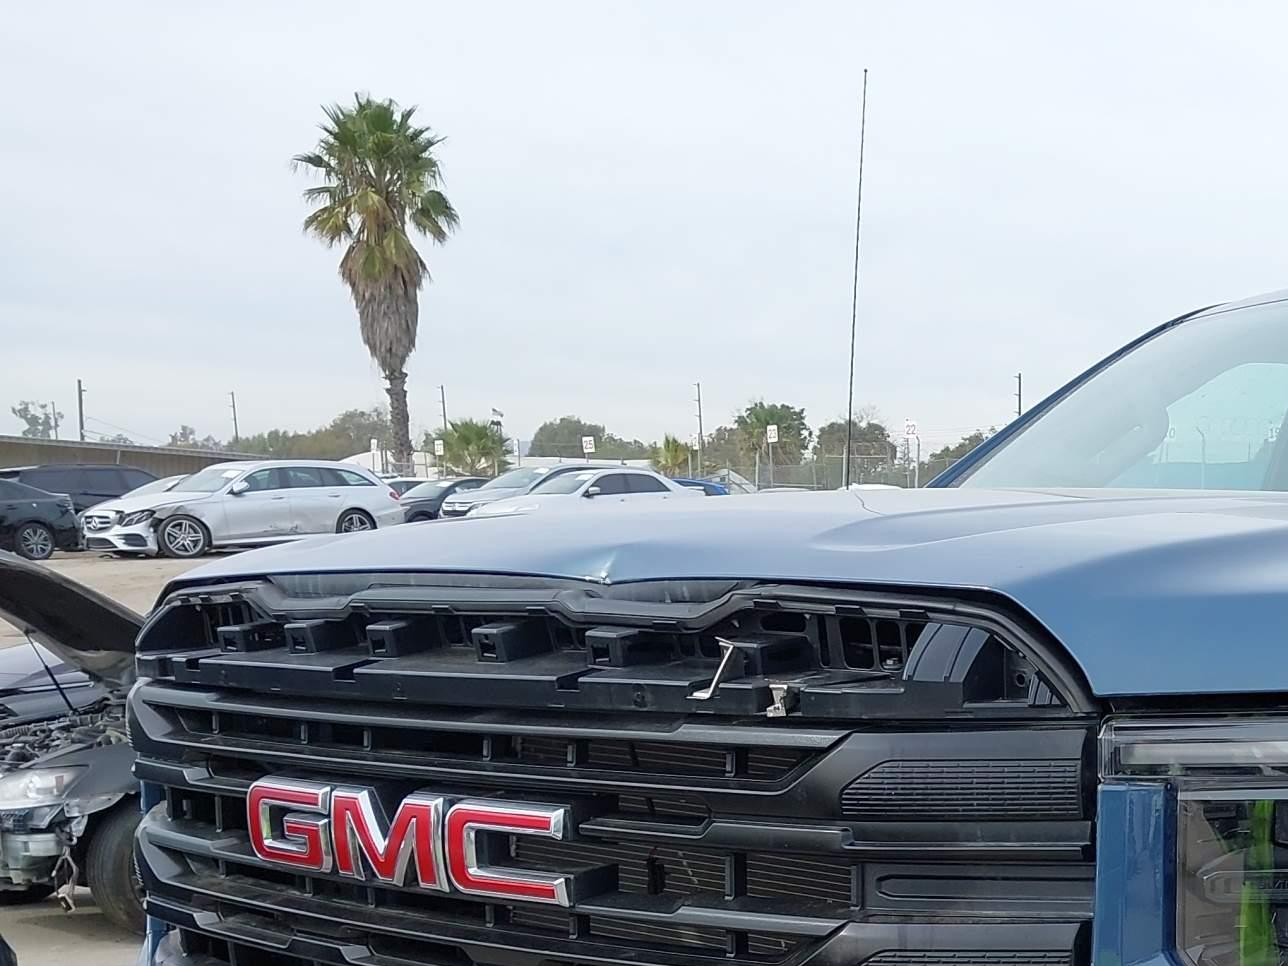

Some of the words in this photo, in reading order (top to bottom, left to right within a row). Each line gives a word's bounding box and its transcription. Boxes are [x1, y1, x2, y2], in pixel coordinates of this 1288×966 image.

[905, 424, 916, 435] 22
[583, 439, 594, 450] 25
[248, 781, 570, 908] GMC
